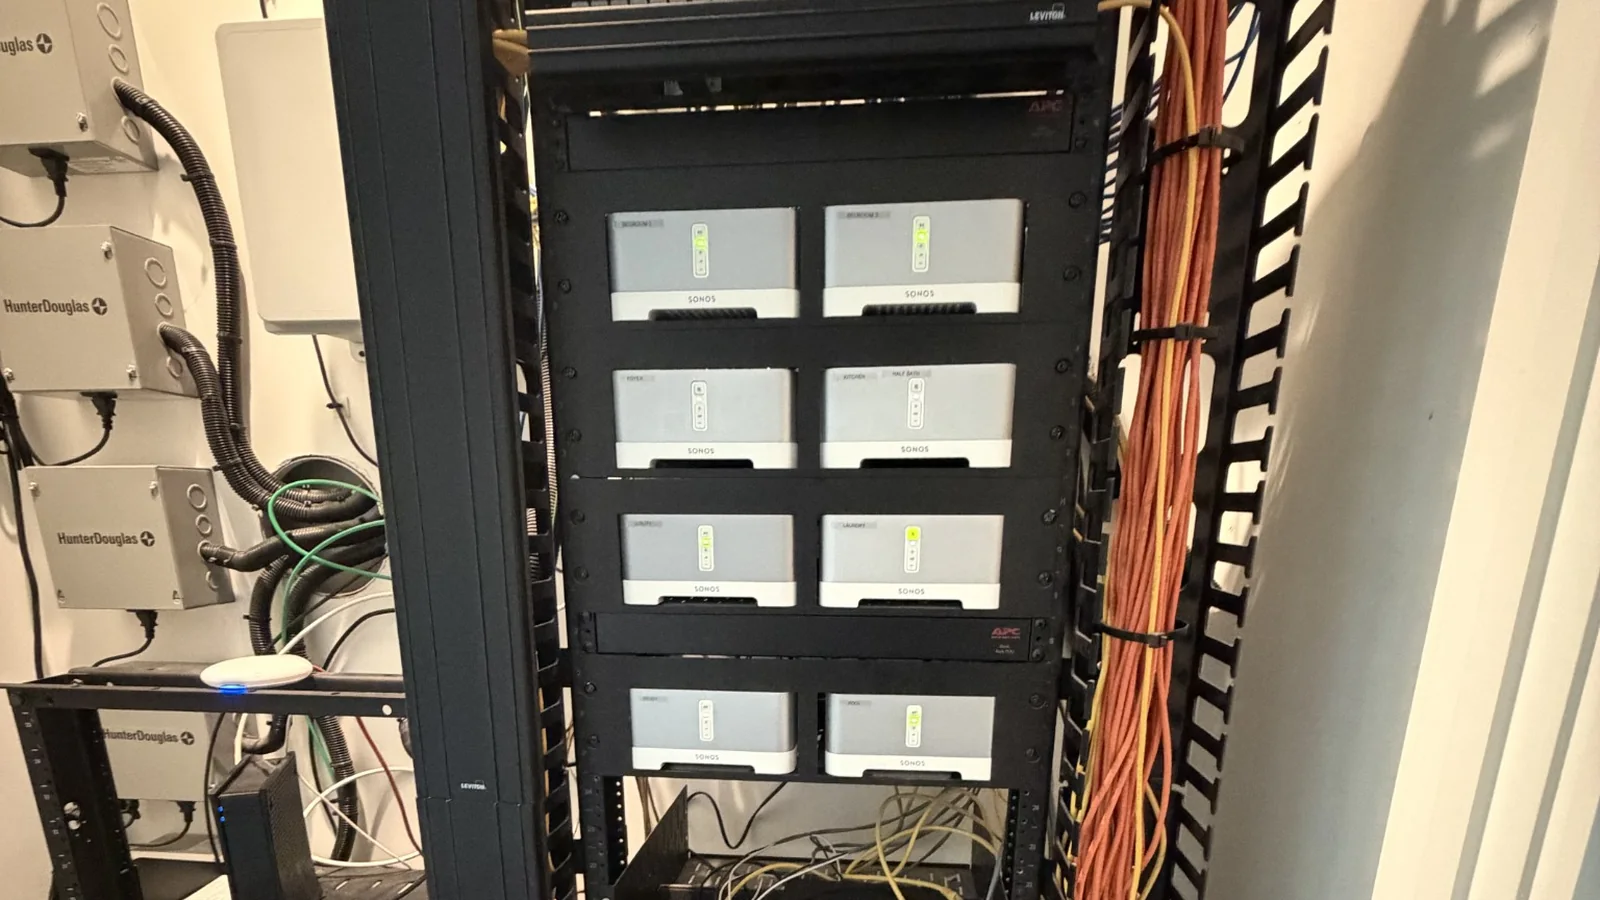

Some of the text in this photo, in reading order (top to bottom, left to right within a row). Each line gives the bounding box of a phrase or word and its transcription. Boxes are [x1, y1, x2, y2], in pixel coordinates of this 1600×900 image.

[1029, 10, 1066, 21] LEVITON
[0, 36, 34, 56] uglas
[905, 289, 934, 298] SONOS
[688, 295, 716, 303] SONOS
[4, 298, 90, 316] HunterDouglas
[688, 447, 715, 455] SONOS
[901, 445, 929, 453] SONOS
[57, 531, 139, 547] HunterDouglas
[992, 628, 1020, 636] APC
[104, 728, 179, 744] HunterDouglas
